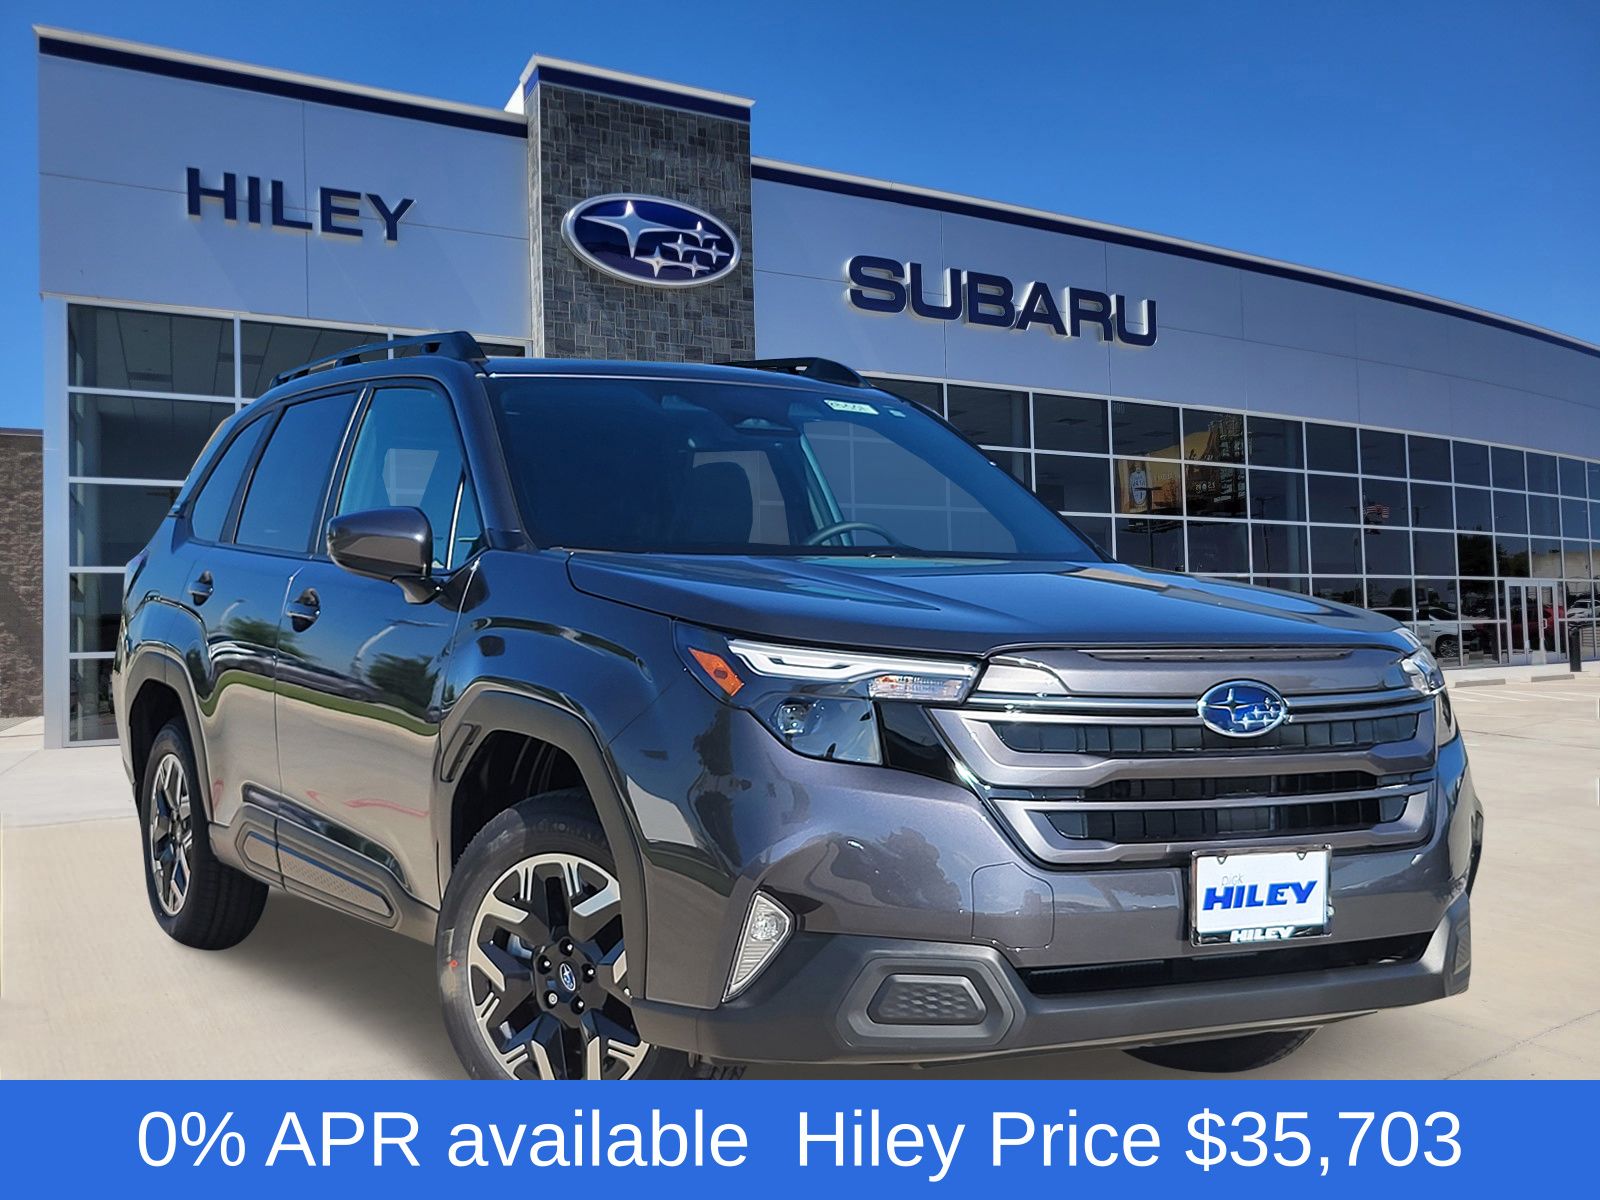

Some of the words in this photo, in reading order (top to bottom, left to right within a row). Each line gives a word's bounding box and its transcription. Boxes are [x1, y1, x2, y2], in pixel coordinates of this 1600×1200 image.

[187, 167, 416, 242] HILEY
[847, 255, 1158, 348] SUBARU
[1202, 880, 1318, 911] HILEY
[1230, 926, 1295, 943] HILEY
